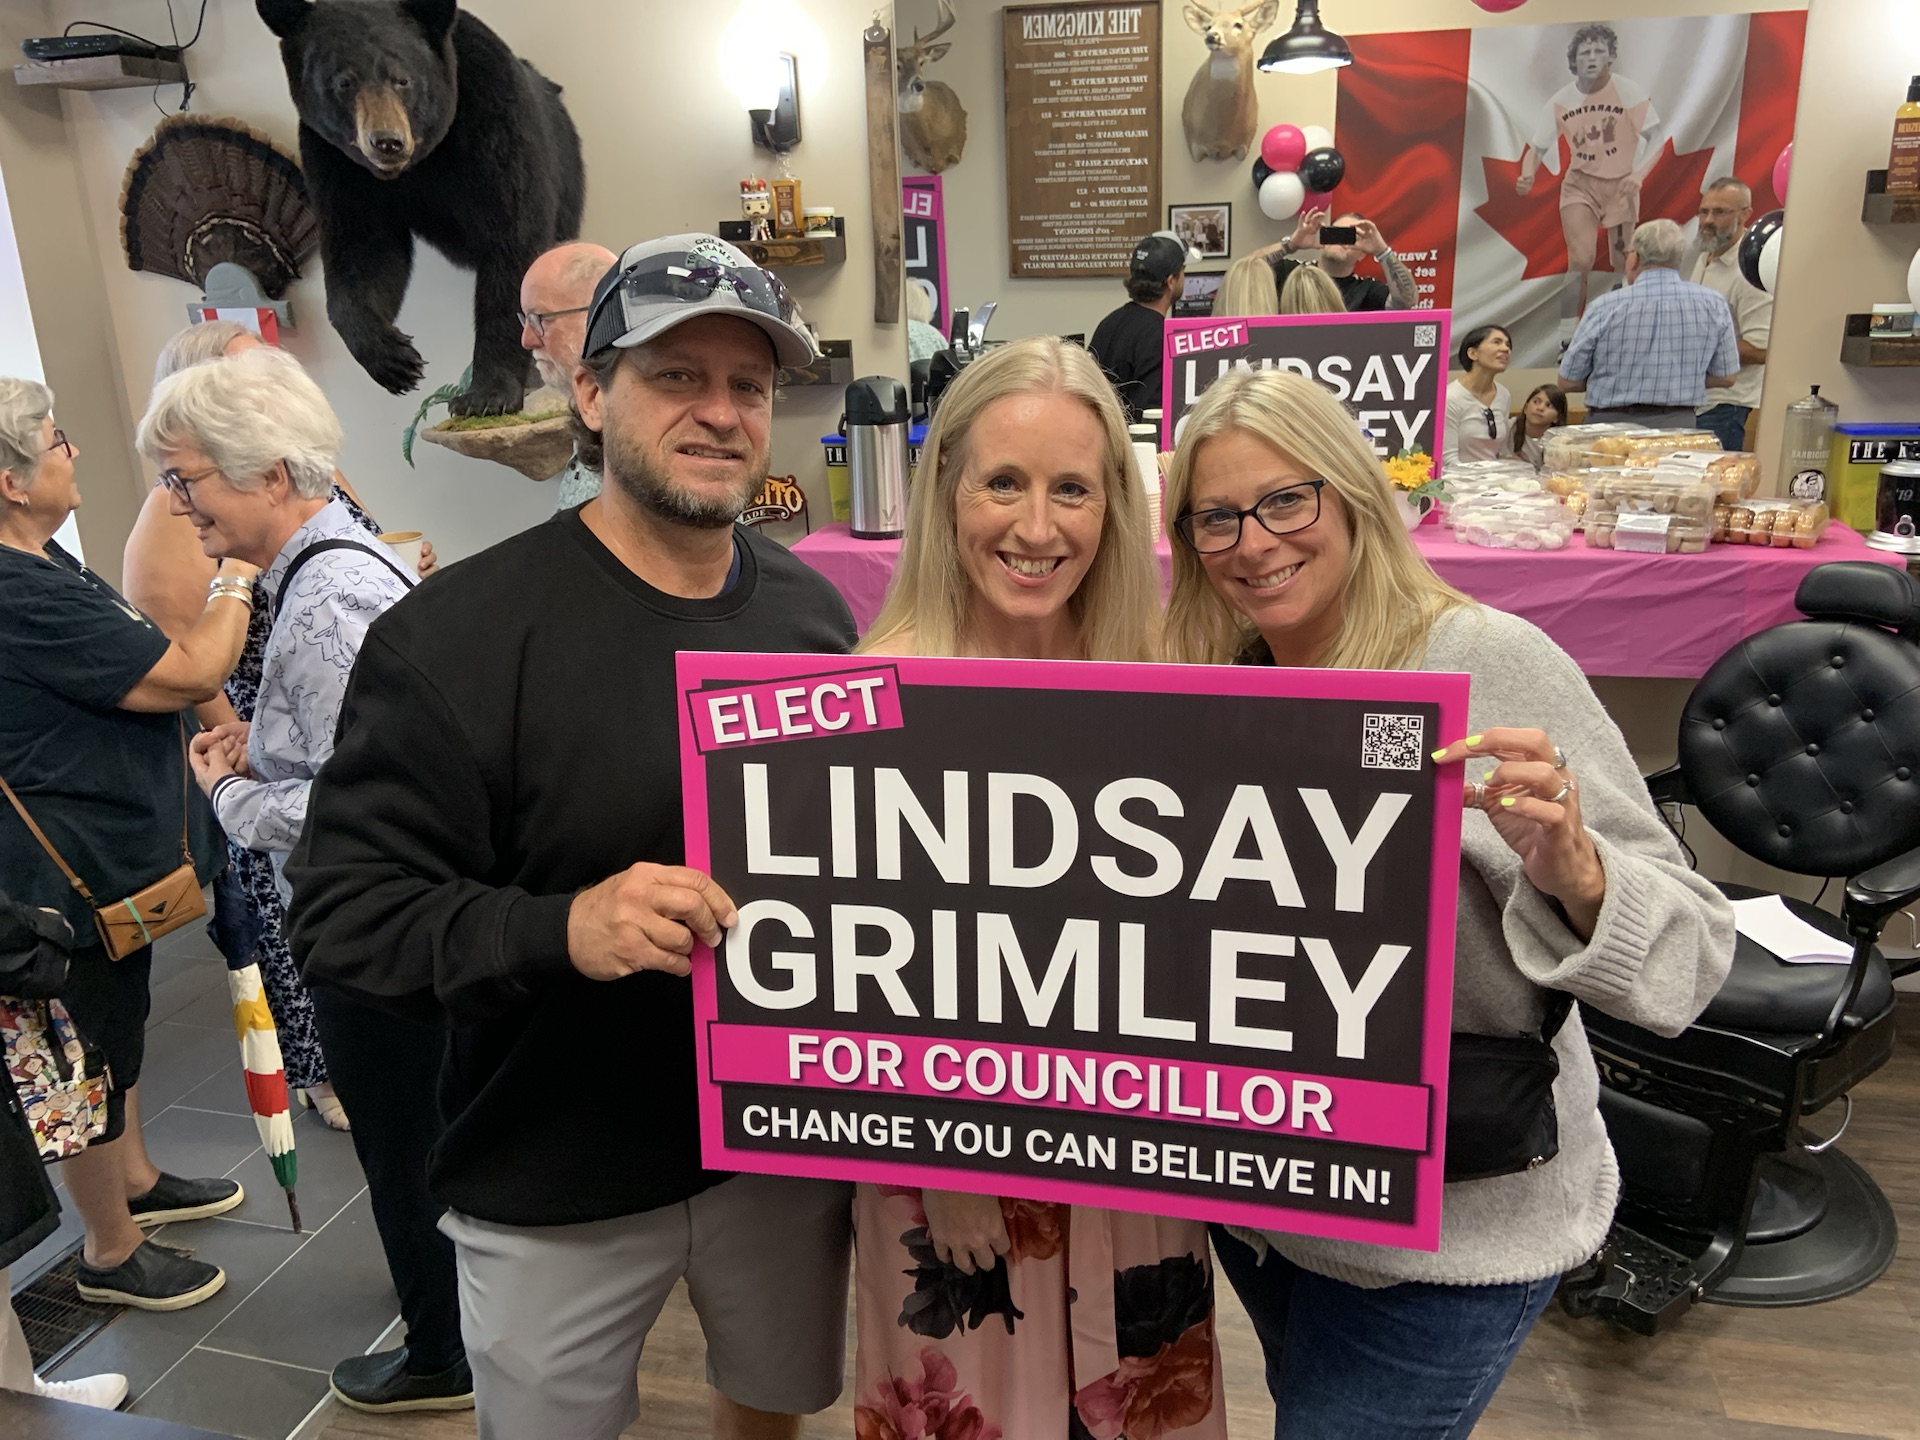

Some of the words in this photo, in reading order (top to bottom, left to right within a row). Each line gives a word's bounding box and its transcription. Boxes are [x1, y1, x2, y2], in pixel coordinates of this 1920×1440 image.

[1898, 122, 1920, 133] REUZE
[687, 244, 736, 266] TOURNAMEN
[695, 237, 724, 248] GOLF
[1174, 324, 1242, 354] ELECT
[827, 448, 848, 462] TH
[1852, 442, 1886, 458] THE
[708, 677, 885, 743] ELECT
[742, 763, 1412, 912] LINDSAY
[725, 900, 1412, 1059] GRIMLEY
[788, 1034, 904, 1087] FOR
[922, 1044, 1333, 1133] COUNCILLOR
[742, 1104, 914, 1149] CHANGE
[925, 1119, 1012, 1158] YOU
[1025, 1130, 1116, 1170] CAN
[1131, 1140, 1315, 1195] BELIEVE
[1329, 1164, 1391, 1205] IN!
